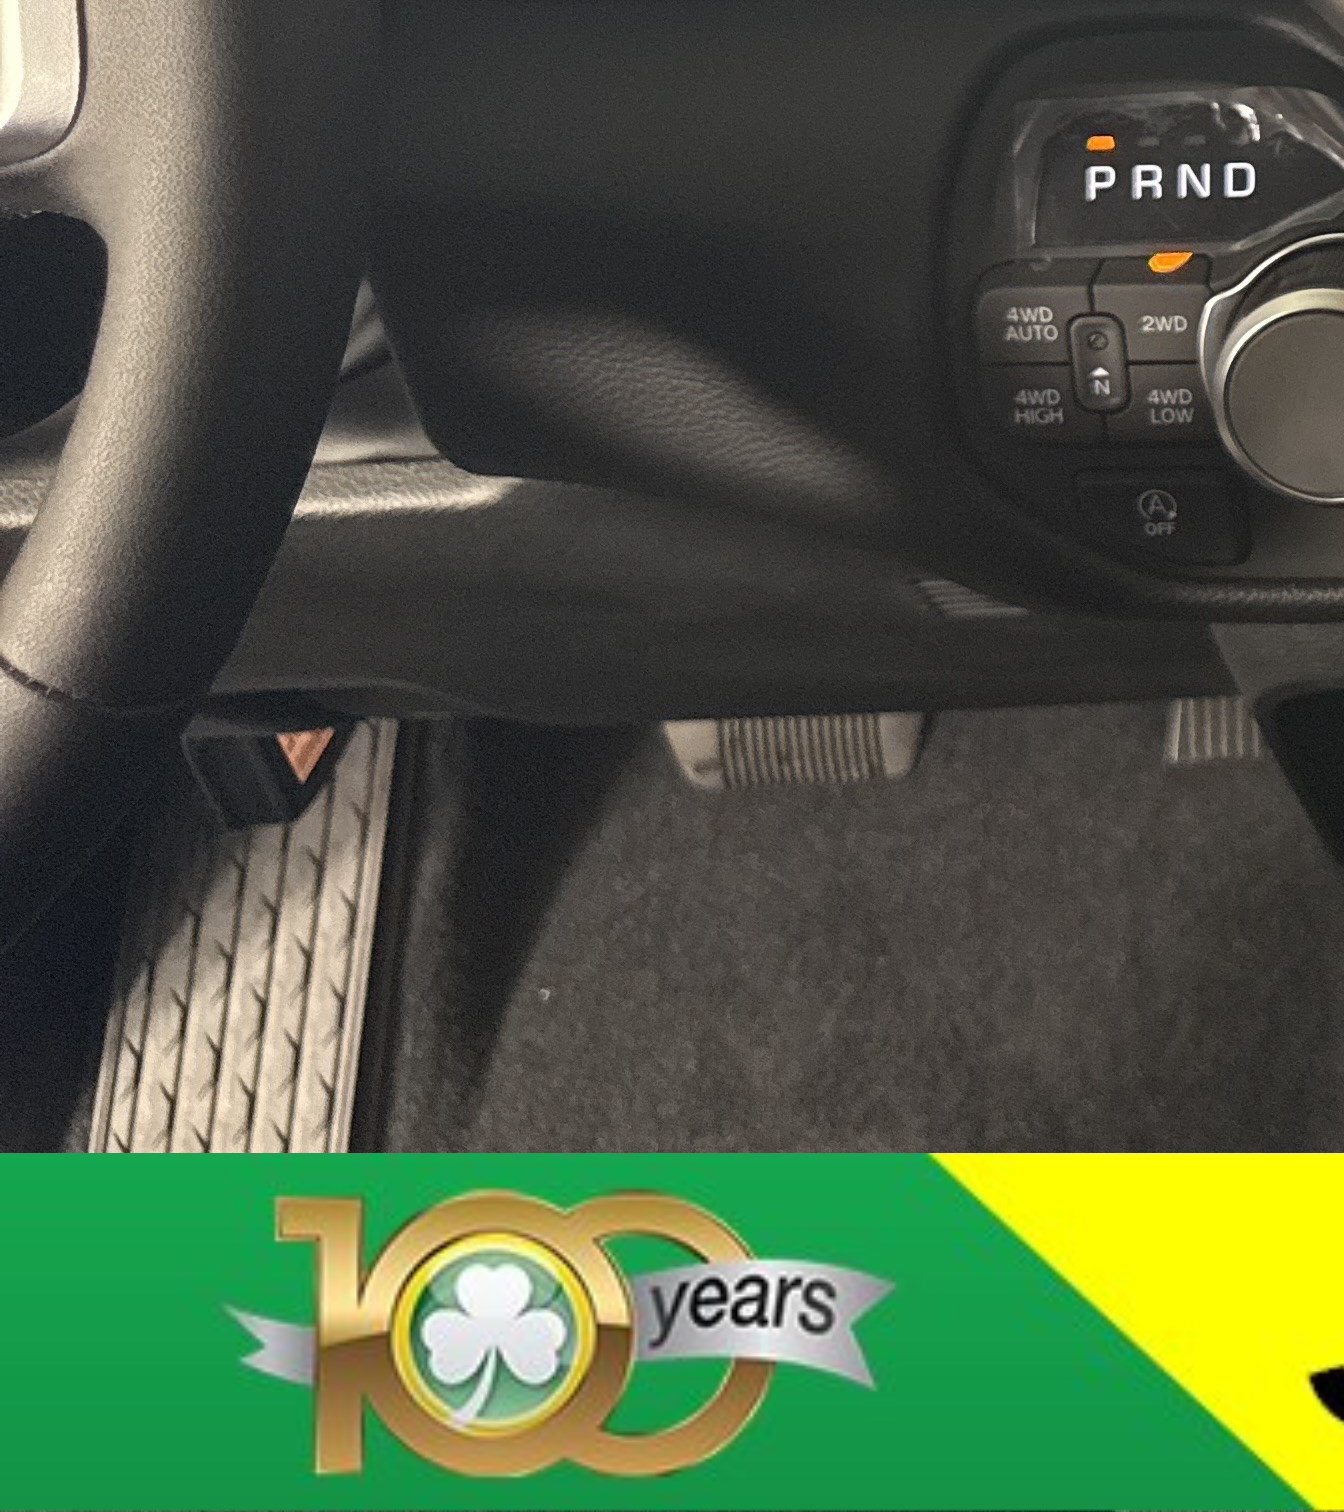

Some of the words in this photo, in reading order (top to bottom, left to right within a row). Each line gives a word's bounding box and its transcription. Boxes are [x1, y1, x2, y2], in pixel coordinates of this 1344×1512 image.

[1006, 306, 1053, 323] 4WD
[1140, 315, 1188, 332] 2WD
[1006, 324, 1059, 341] AUTO
[1091, 378, 1111, 396] N
[1014, 388, 1062, 406] 4WD
[1147, 388, 1193, 406] 4WD
[1014, 407, 1064, 425] HIGH
[1150, 407, 1195, 425] LOW
[1144, 521, 1177, 537] OFF
